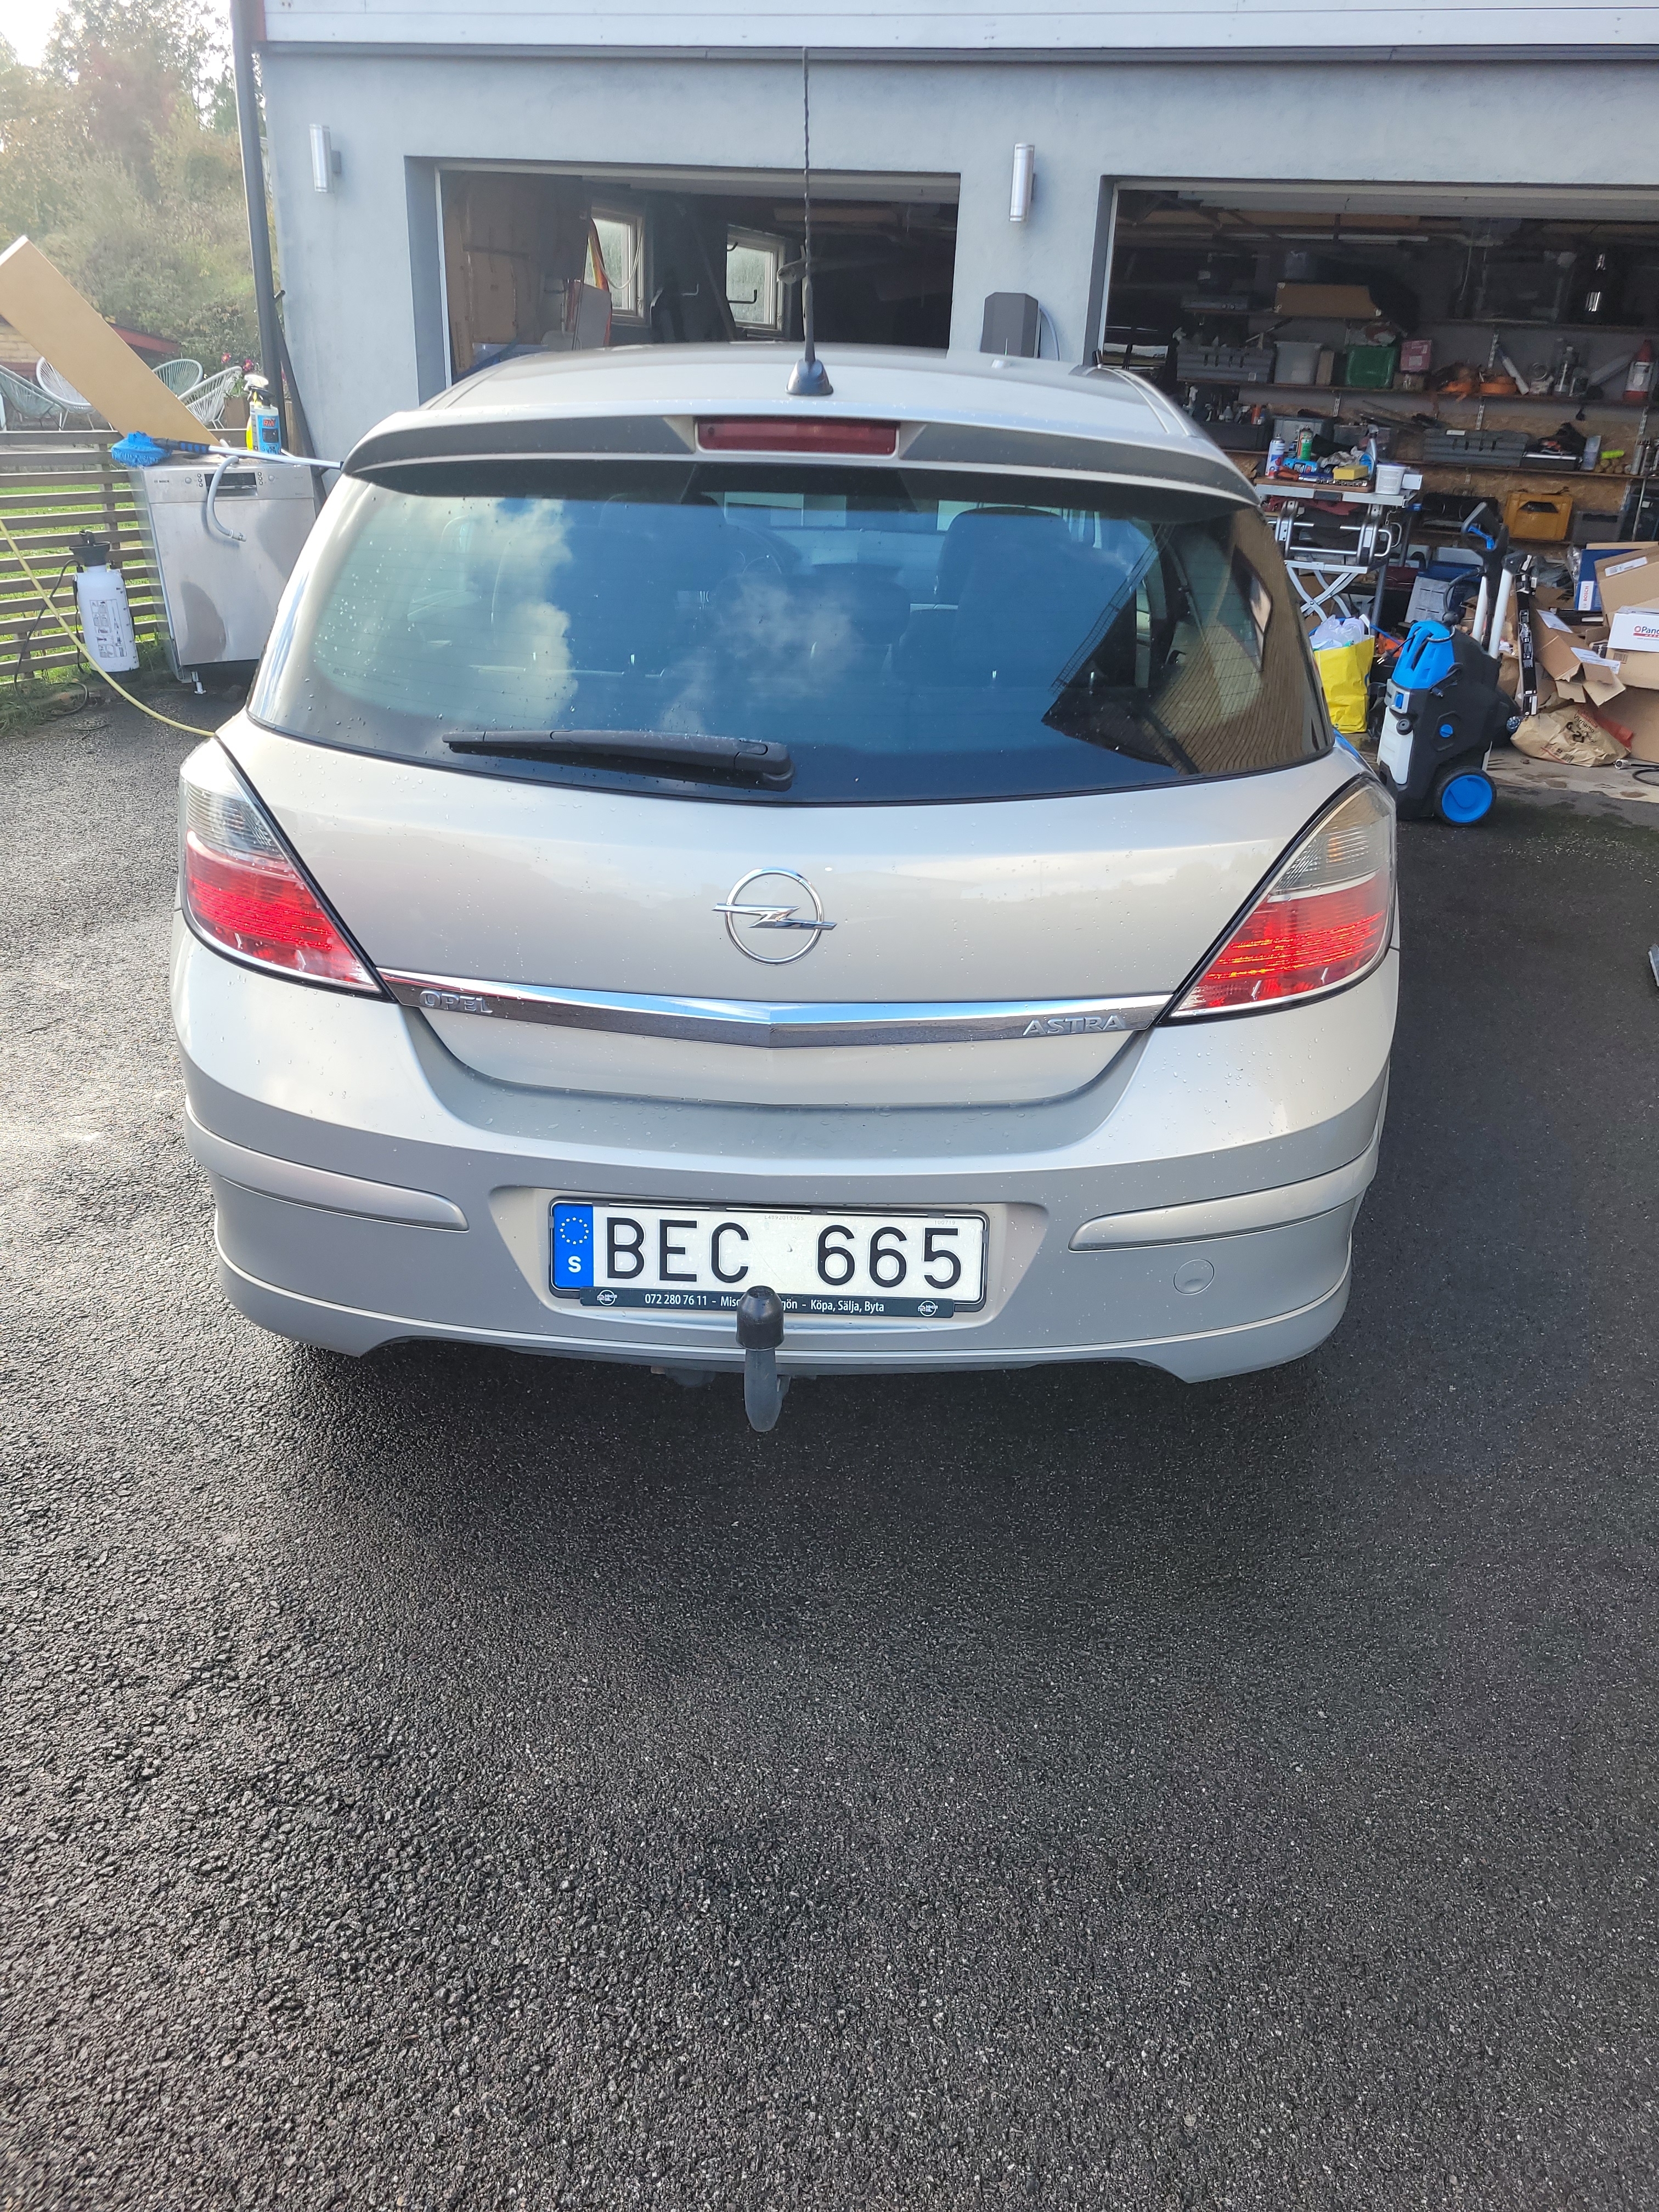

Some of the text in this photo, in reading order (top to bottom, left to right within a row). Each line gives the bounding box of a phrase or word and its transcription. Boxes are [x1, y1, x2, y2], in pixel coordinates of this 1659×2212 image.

[419, 990, 493, 1014] OPEL
[1022, 1014, 1126, 1036] ASTRA
[568, 1255, 582, 1273] S
[606, 1217, 961, 1289] BEC 665
[645, 1294, 662, 1305] 072
[664, 1294, 681, 1305] 280
[683, 1295, 695, 1305] 76
[697, 1295, 707, 1306] 11
[781, 1299, 798, 1311] gön
[811, 1299, 836, 1312] Köpa,
[838, 1300, 862, 1313] Sälja,
[864, 1301, 884, 1314] Byta
